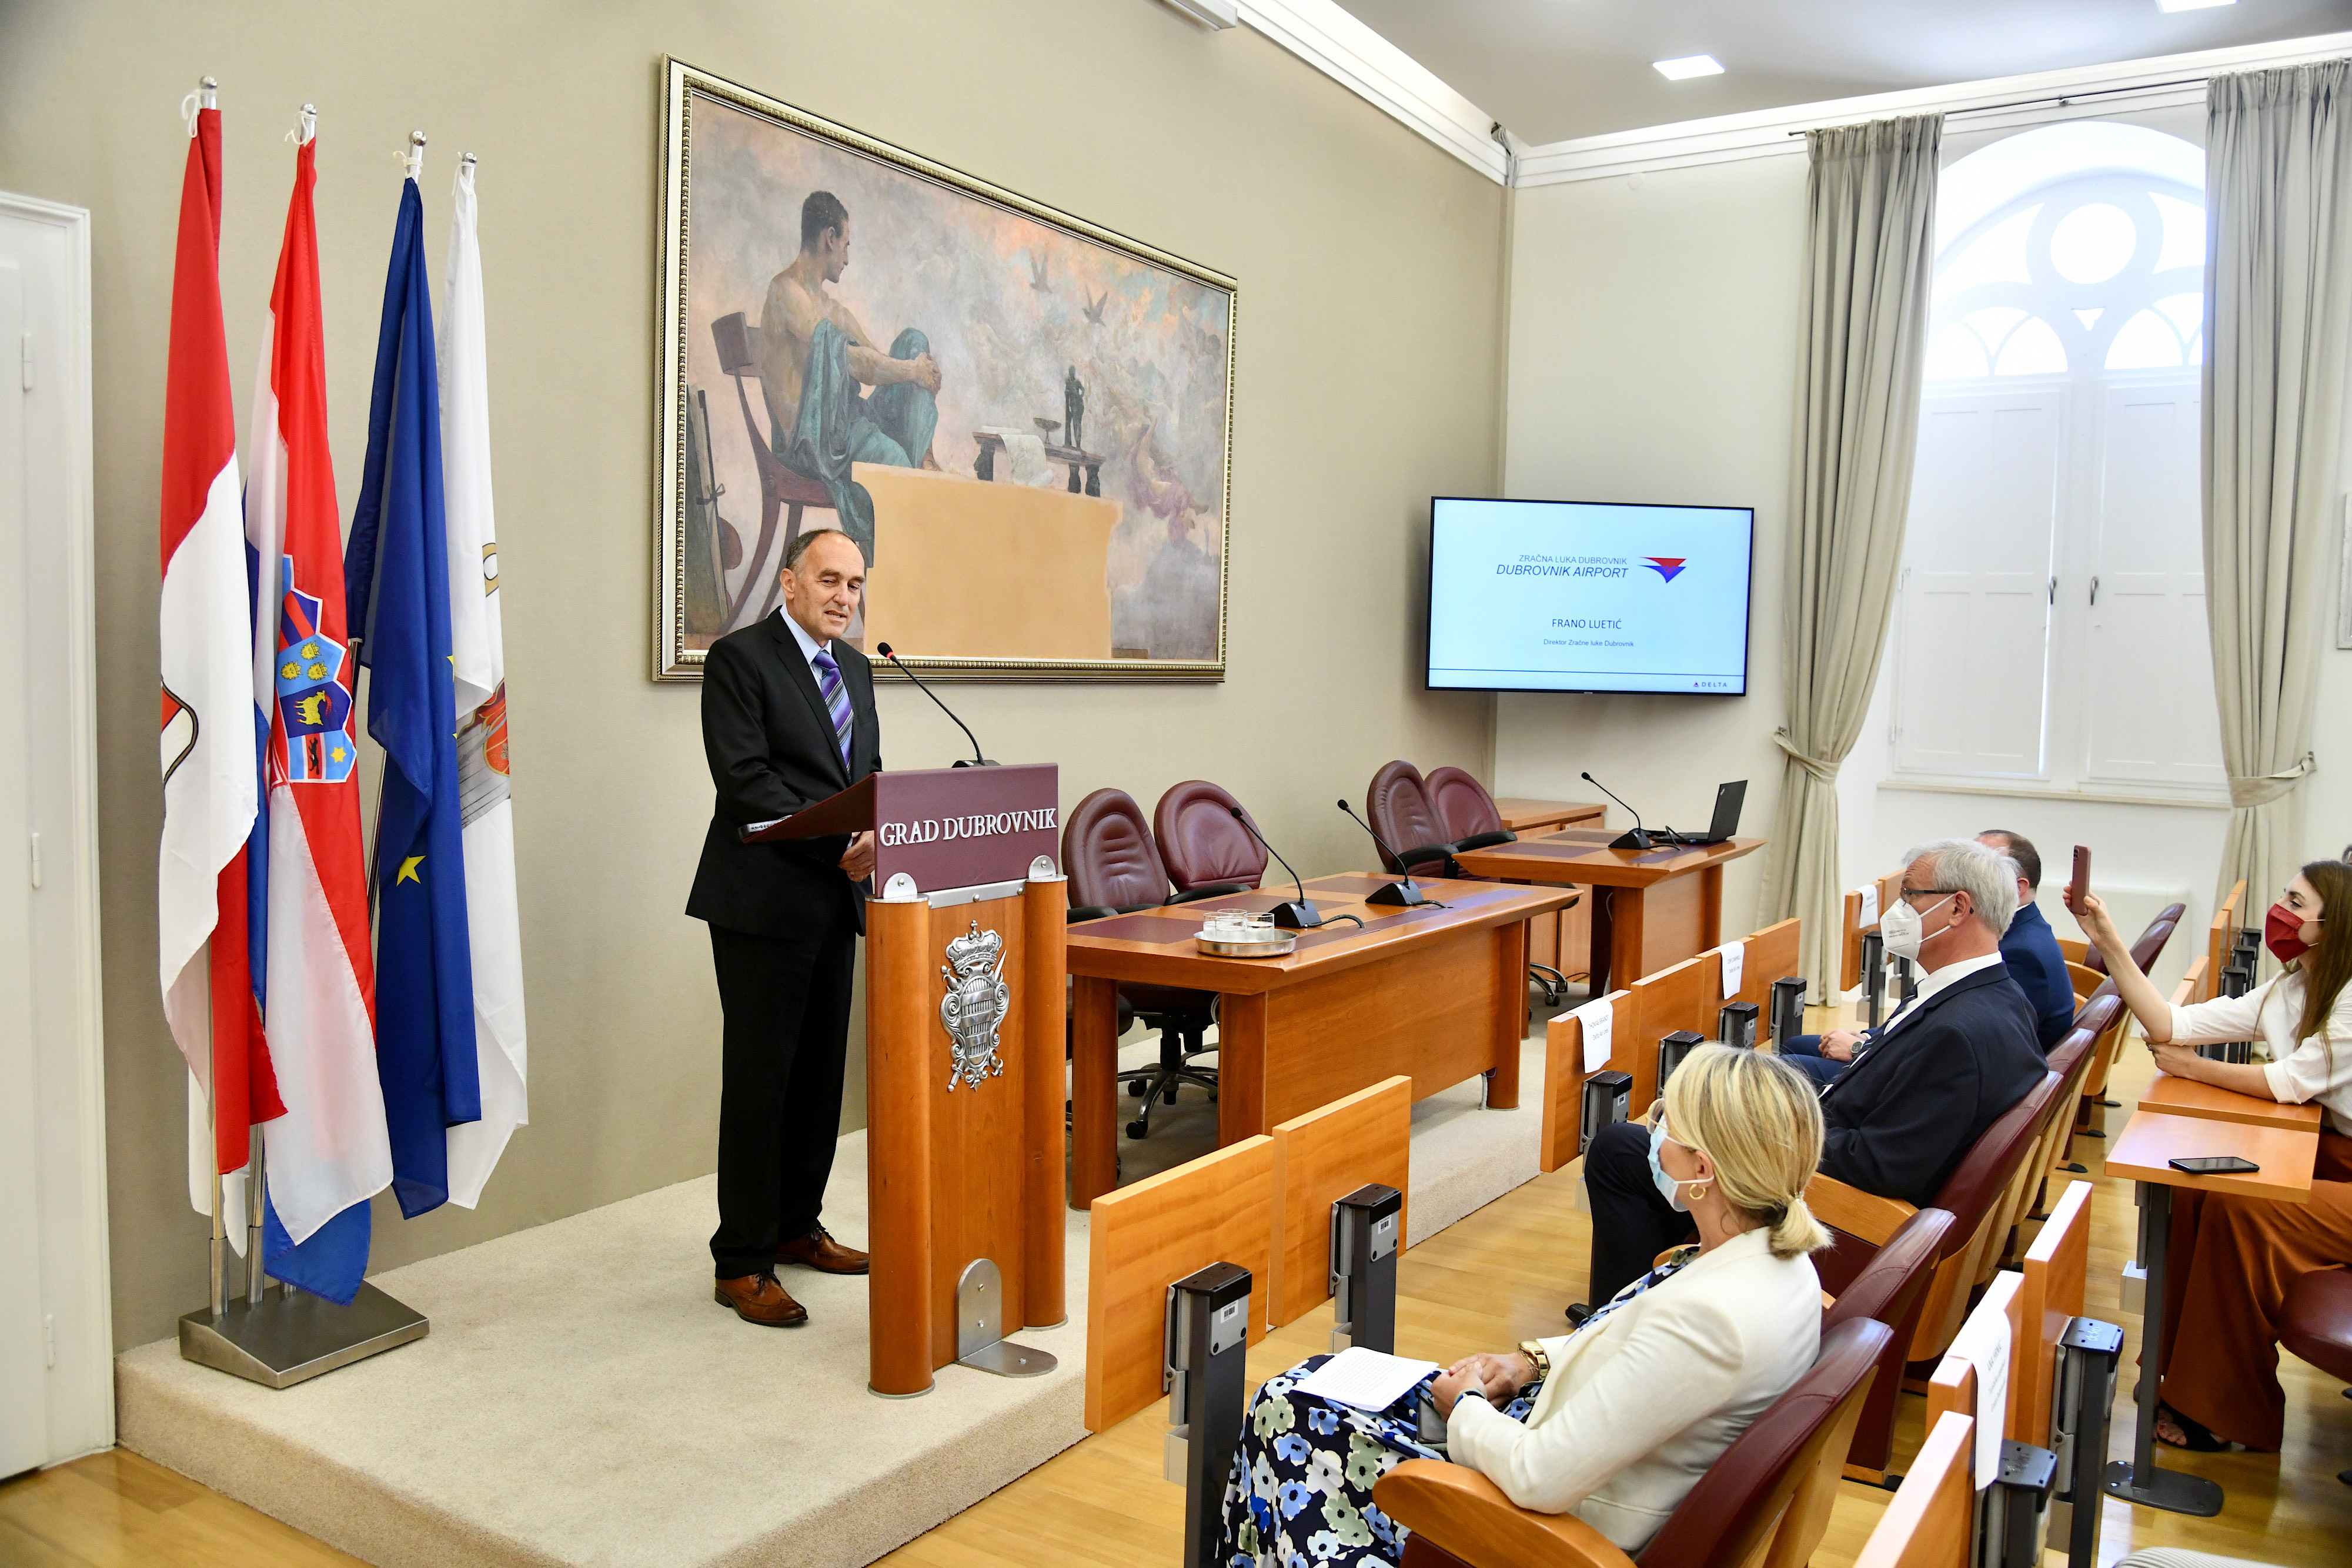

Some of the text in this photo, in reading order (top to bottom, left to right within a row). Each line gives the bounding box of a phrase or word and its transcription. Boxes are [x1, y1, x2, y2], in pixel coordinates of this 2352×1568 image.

[1519, 554, 1553, 563] ZRAČNA
[1496, 564, 1629, 577] DUBROVNIK AIRPORT
[1552, 618, 1622, 629] FRANO LUETIĆ
[879, 808, 1057, 847] GRAD DUBROVNIK
[1588, 1019, 1599, 1029] THOMAS
